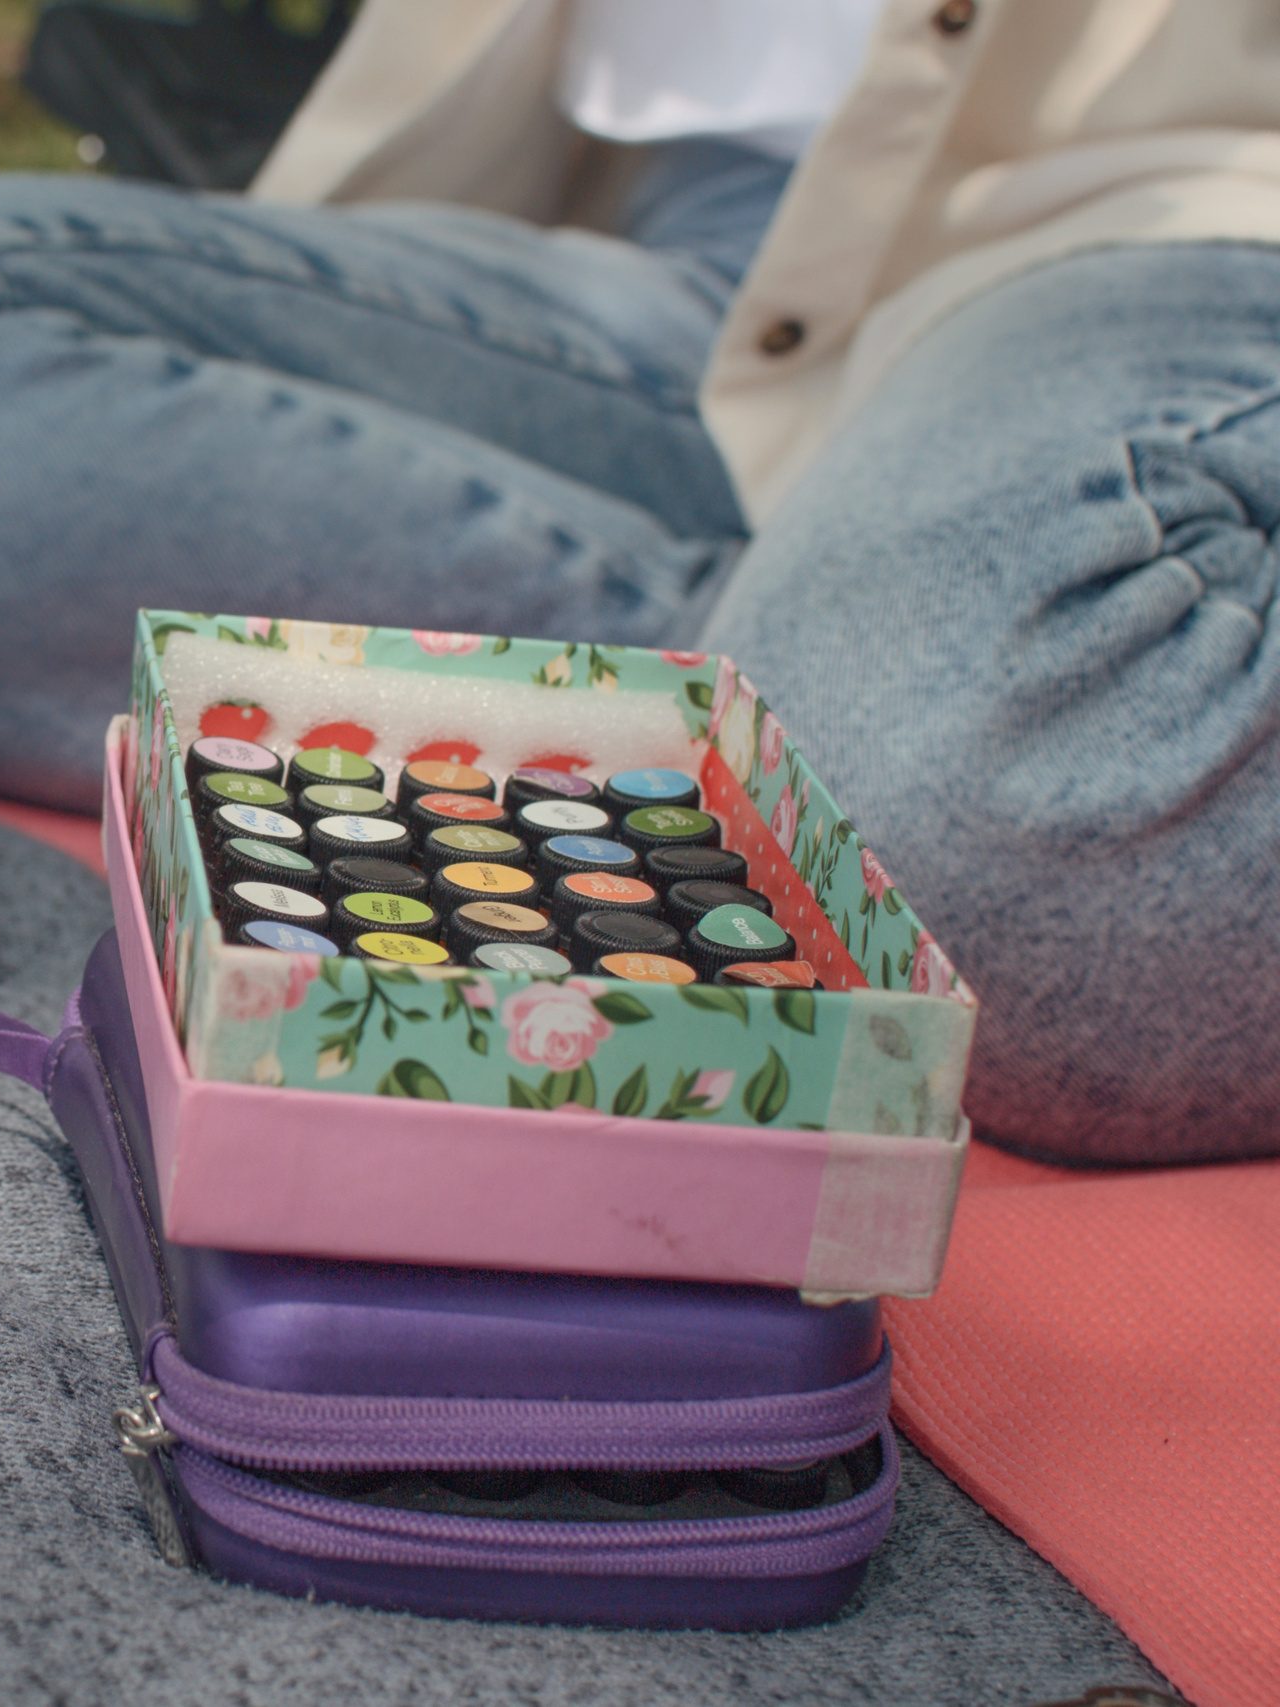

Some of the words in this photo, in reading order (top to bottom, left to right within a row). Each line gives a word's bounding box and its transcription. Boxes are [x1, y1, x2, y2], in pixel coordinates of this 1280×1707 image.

[270, 888, 290, 909] Melissa
[370, 900, 384, 916] Lemon
[482, 905, 521, 923] Ginger
[732, 917, 764, 946] Balance
[493, 950, 524, 969] Black
[511, 948, 548, 970] Pepper
